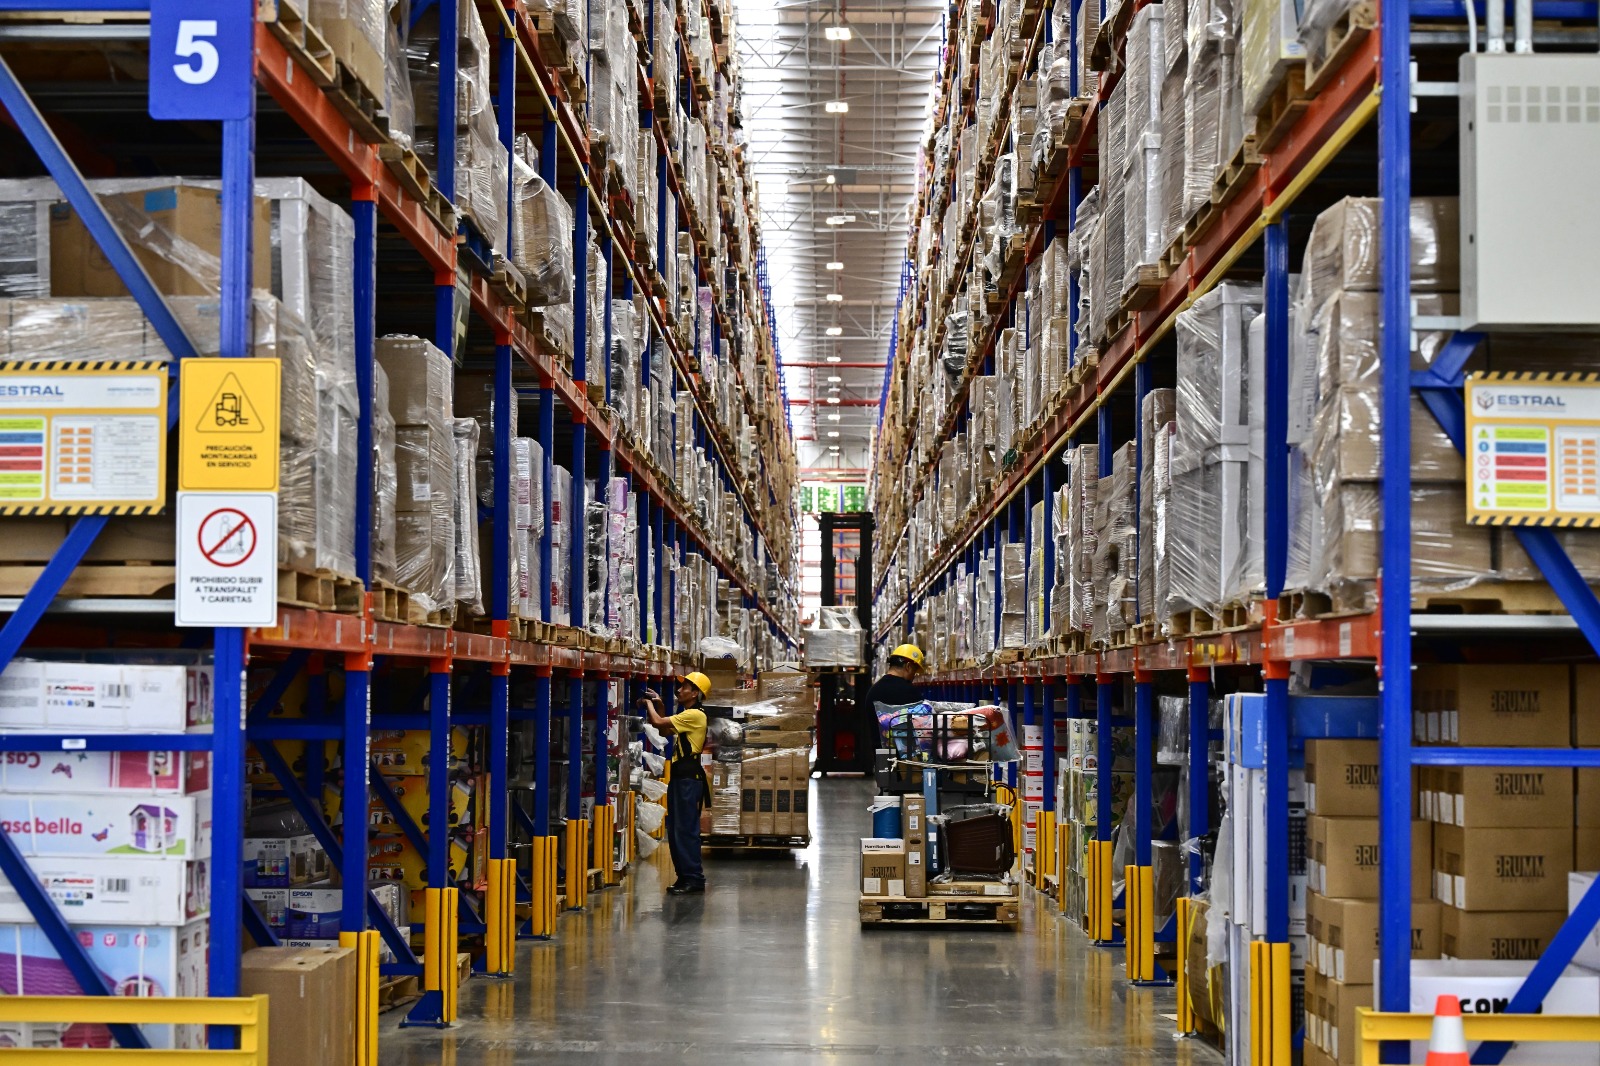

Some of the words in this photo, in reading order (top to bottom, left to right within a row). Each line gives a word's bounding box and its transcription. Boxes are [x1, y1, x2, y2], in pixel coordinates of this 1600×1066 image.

[173, 20, 220, 85] 5
[1497, 395, 1566, 406] ESTRAL
[190, 576, 237, 584] PROHIBIDO
[239, 576, 263, 584] SUBIR
[1490, 690, 1540, 712] BRUMM
[1493, 773, 1545, 795] BRUMM
[870, 867, 897, 878] BRUMM
[1494, 855, 1544, 877] BRUMM
[1490, 938, 1540, 960] BRUMM
